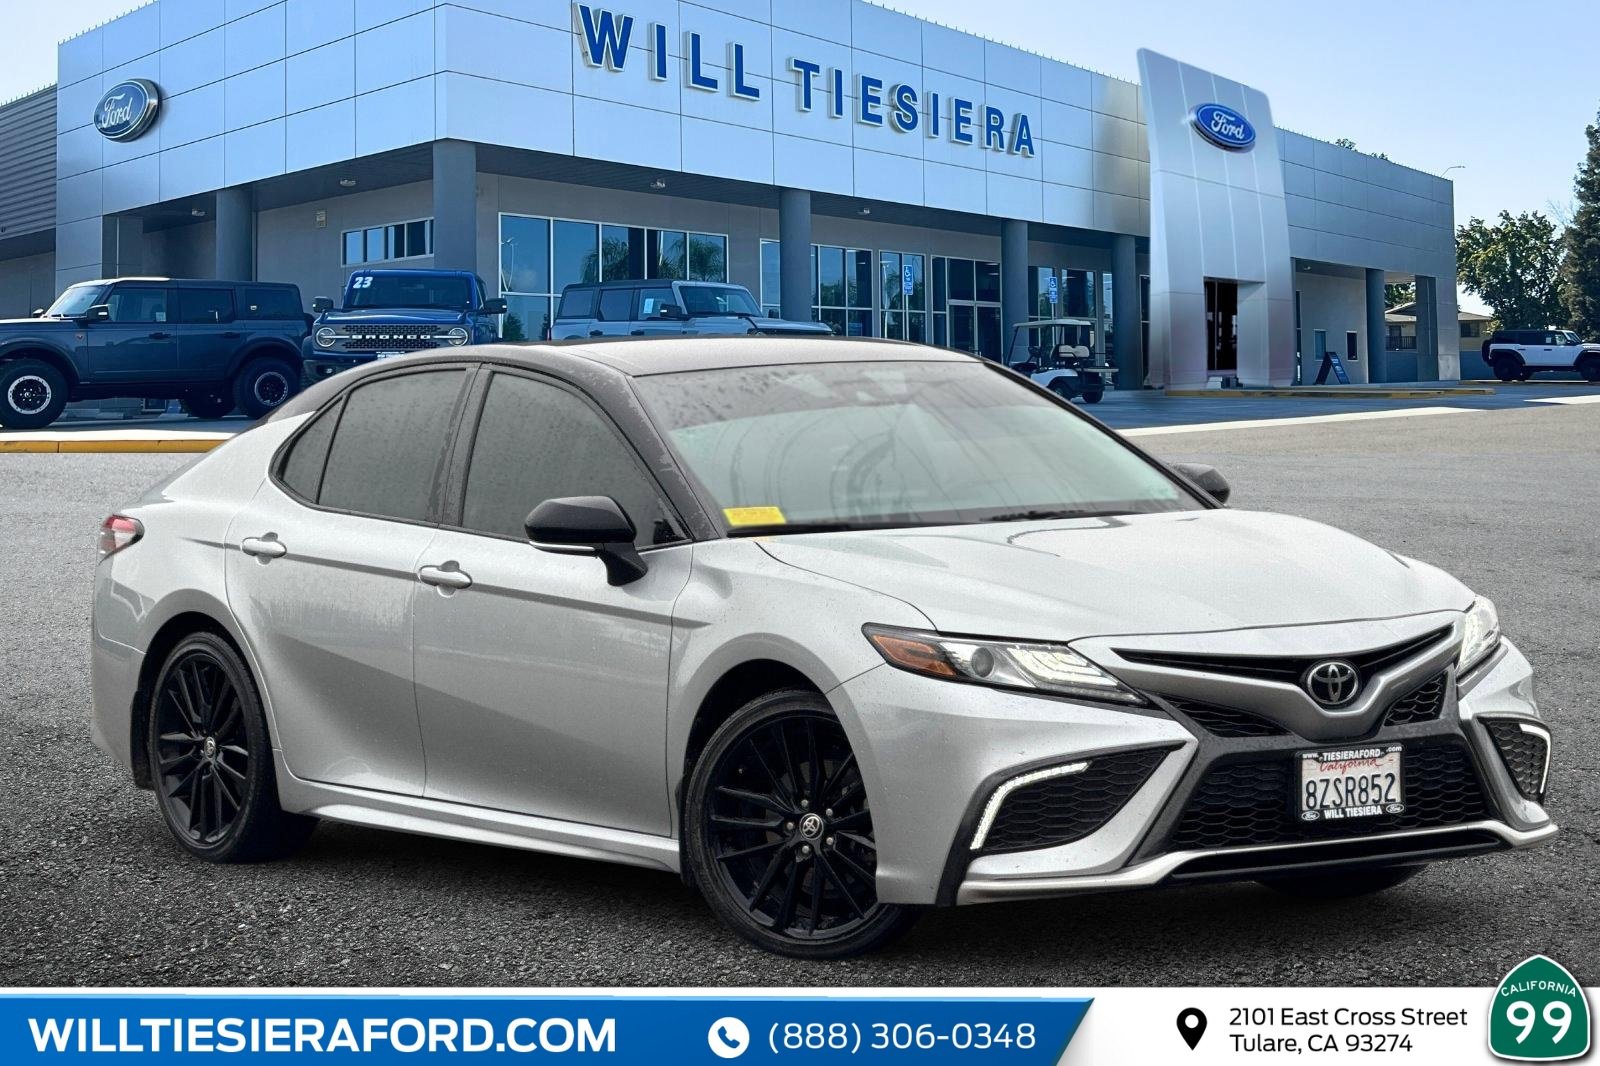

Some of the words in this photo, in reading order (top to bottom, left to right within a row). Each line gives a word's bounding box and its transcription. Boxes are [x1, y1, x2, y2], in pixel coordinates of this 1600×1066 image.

[575, 2, 760, 100] WILL
[788, 56, 1036, 158] TIESIERA
[101, 93, 133, 128] Ford
[1211, 110, 1245, 140] Ford
[352, 276, 374, 289] 23
[1319, 758, 1382, 774] California
[1306, 772, 1396, 809] 8ZSR852
[1324, 809, 1345, 819] WILL
[1346, 805, 1383, 817] TIESIERA
